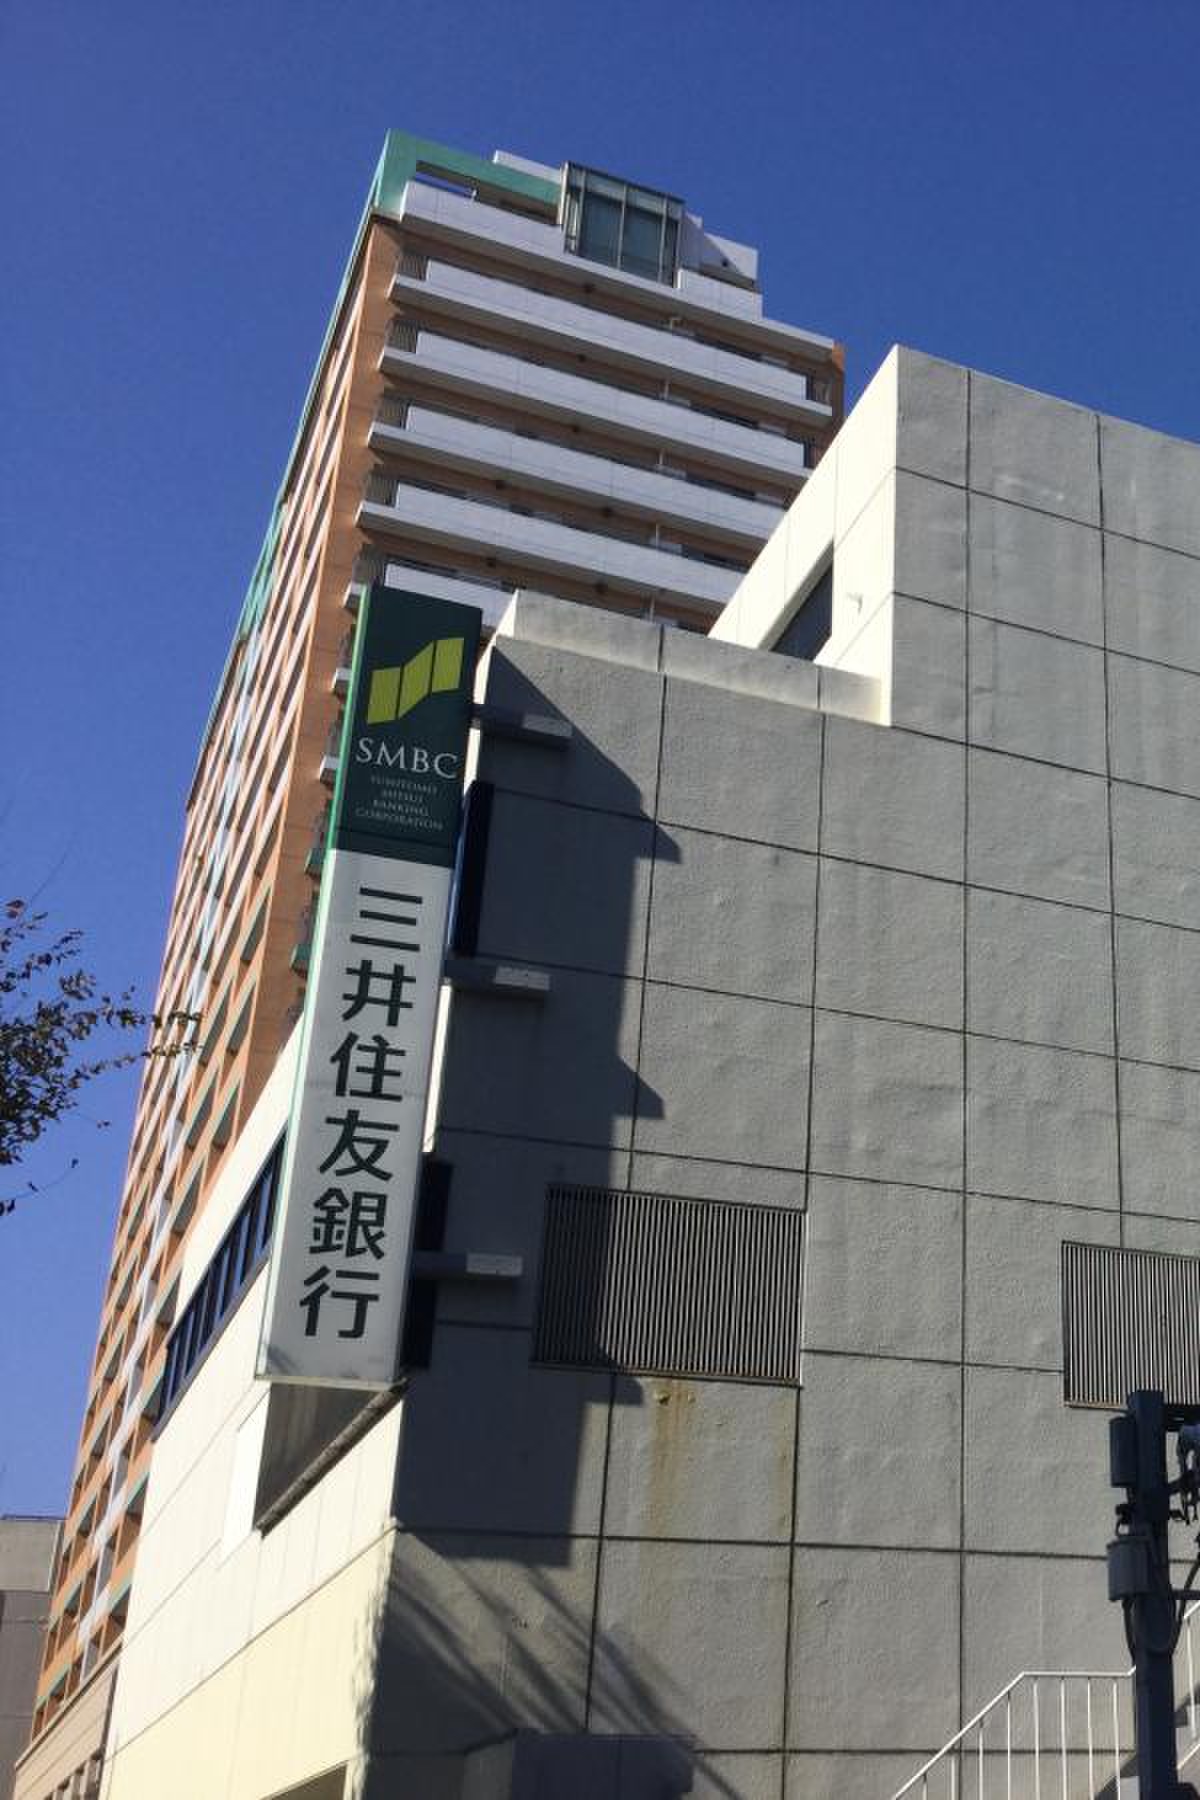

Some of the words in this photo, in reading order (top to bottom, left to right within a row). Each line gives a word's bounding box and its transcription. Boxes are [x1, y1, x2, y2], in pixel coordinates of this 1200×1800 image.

[356, 737, 458, 779] SMBC
[299, 887, 423, 1339] 三井住友銀行
